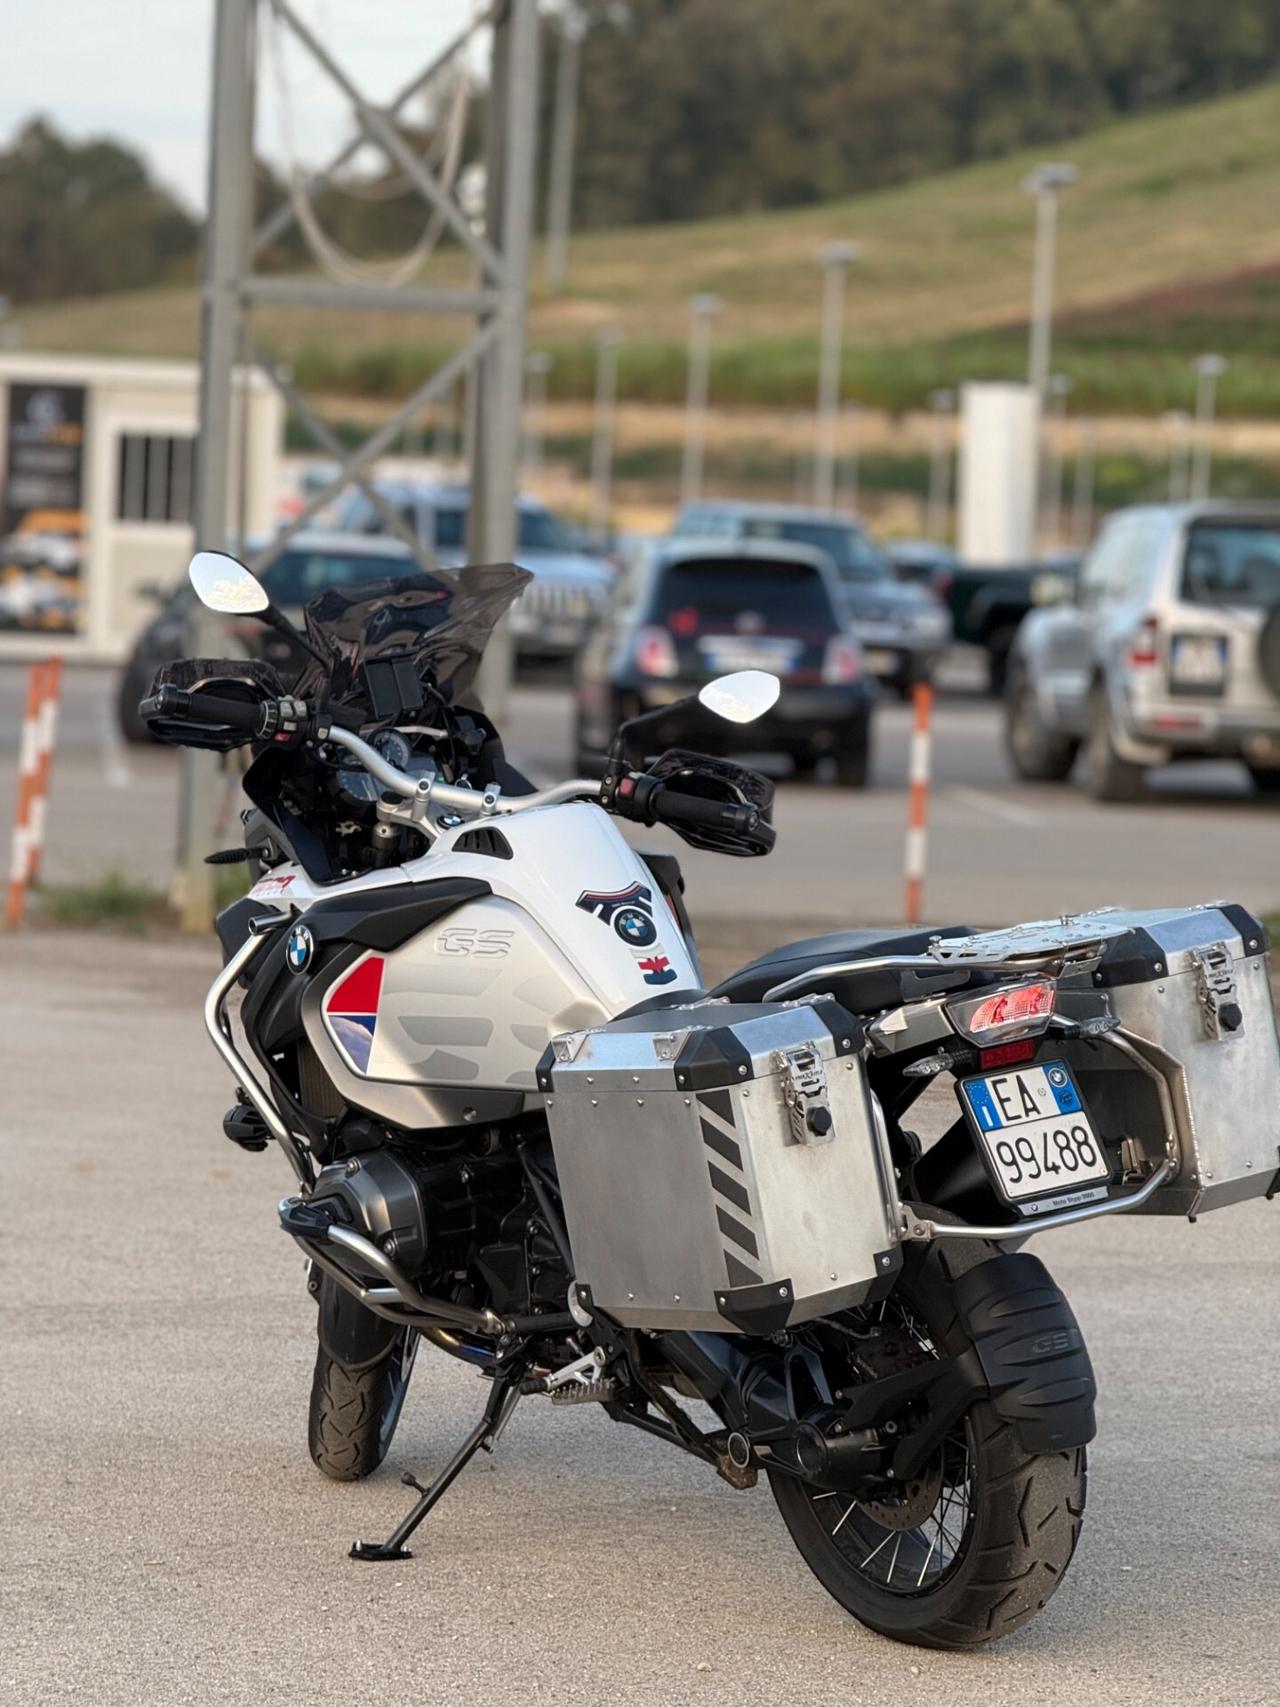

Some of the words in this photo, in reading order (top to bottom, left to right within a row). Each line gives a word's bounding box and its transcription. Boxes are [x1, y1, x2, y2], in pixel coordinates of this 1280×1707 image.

[435, 927, 515, 959] GS
[992, 1075, 1041, 1121] EA
[996, 1125, 1097, 1183] 99488
[1032, 1332, 1069, 1353] GS
